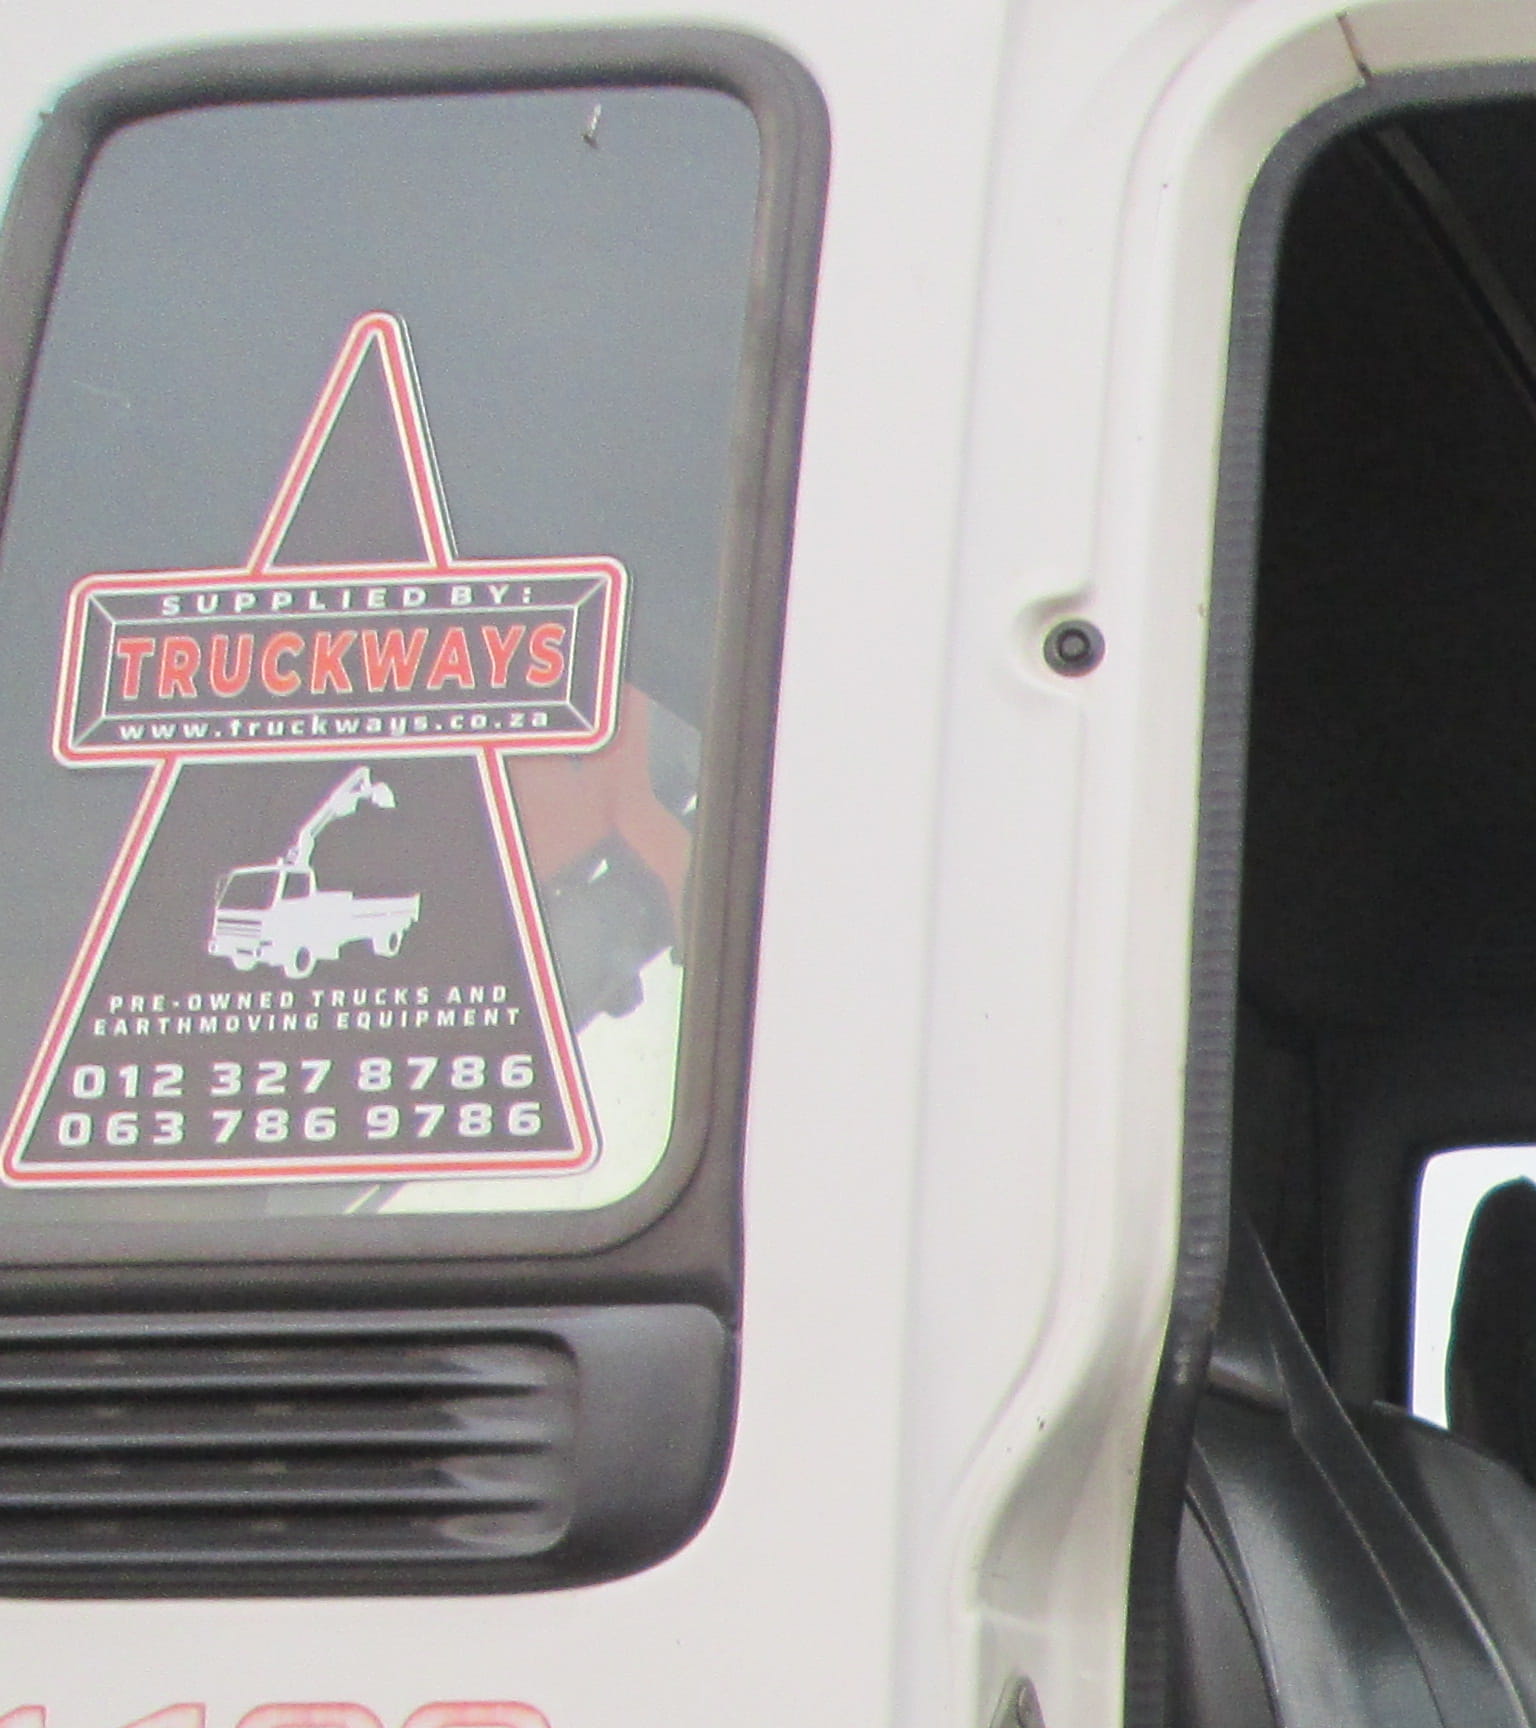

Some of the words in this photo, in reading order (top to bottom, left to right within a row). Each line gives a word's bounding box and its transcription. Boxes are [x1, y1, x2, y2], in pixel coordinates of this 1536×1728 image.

[161, 586, 427, 616] SUPPLIED
[450, 583, 533, 608] BY:
[116, 622, 568, 699] TRUCKWAYS
[118, 709, 551, 741] www.truckways.co.za
[110, 990, 295, 1012] PRE-OWNED
[312, 986, 431, 1007] TRUCKS
[447, 983, 508, 1005] AND
[93, 1011, 321, 1036] EARTHMOVING
[336, 1007, 522, 1031] EQUIPMENT
[72, 1061, 186, 1099] 012
[209, 1058, 333, 1098] 327
[357, 1053, 537, 1094] 8786
[56, 1109, 187, 1147] 063
[212, 1104, 338, 1143] 786
[364, 1100, 544, 1140] 9786
